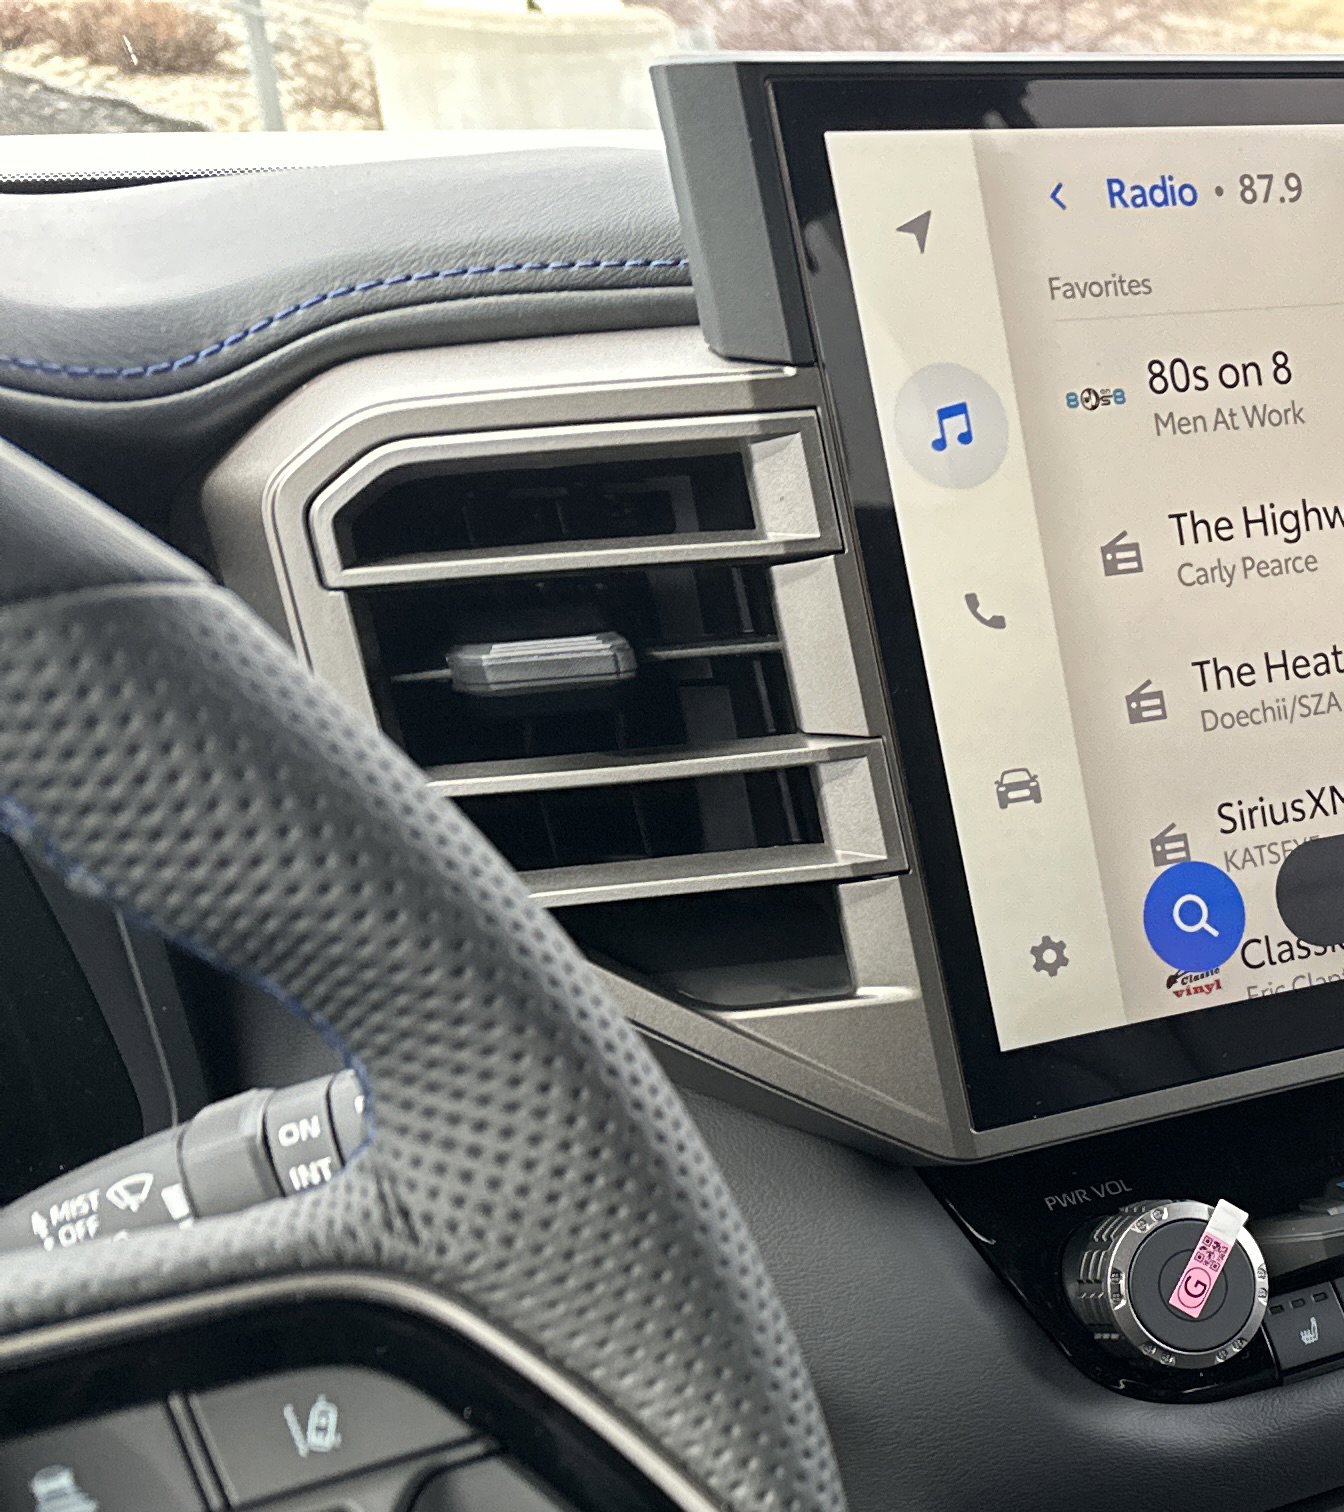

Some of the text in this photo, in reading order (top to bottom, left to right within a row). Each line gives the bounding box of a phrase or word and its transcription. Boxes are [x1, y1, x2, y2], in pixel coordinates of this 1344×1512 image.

[1106, 172, 1303, 209] Radio 87.9
[1048, 273, 1152, 301] Favorites
[1148, 350, 1293, 395] 80s on 8
[1153, 399, 1306, 436] Men At Work
[1168, 510, 1234, 546] The
[1177, 553, 1319, 588] Carly Pearce
[1191, 658, 1256, 693] The
[1199, 691, 1343, 733] Doechii/SZA
[1223, 835, 1320, 872] KATSE
[278, 1115, 321, 1147] ON
[288, 1157, 334, 1191] INT
[50, 1191, 100, 1226] MIST
[1044, 1179, 1133, 1211] PWR VOL
[58, 1216, 100, 1248] OFF
